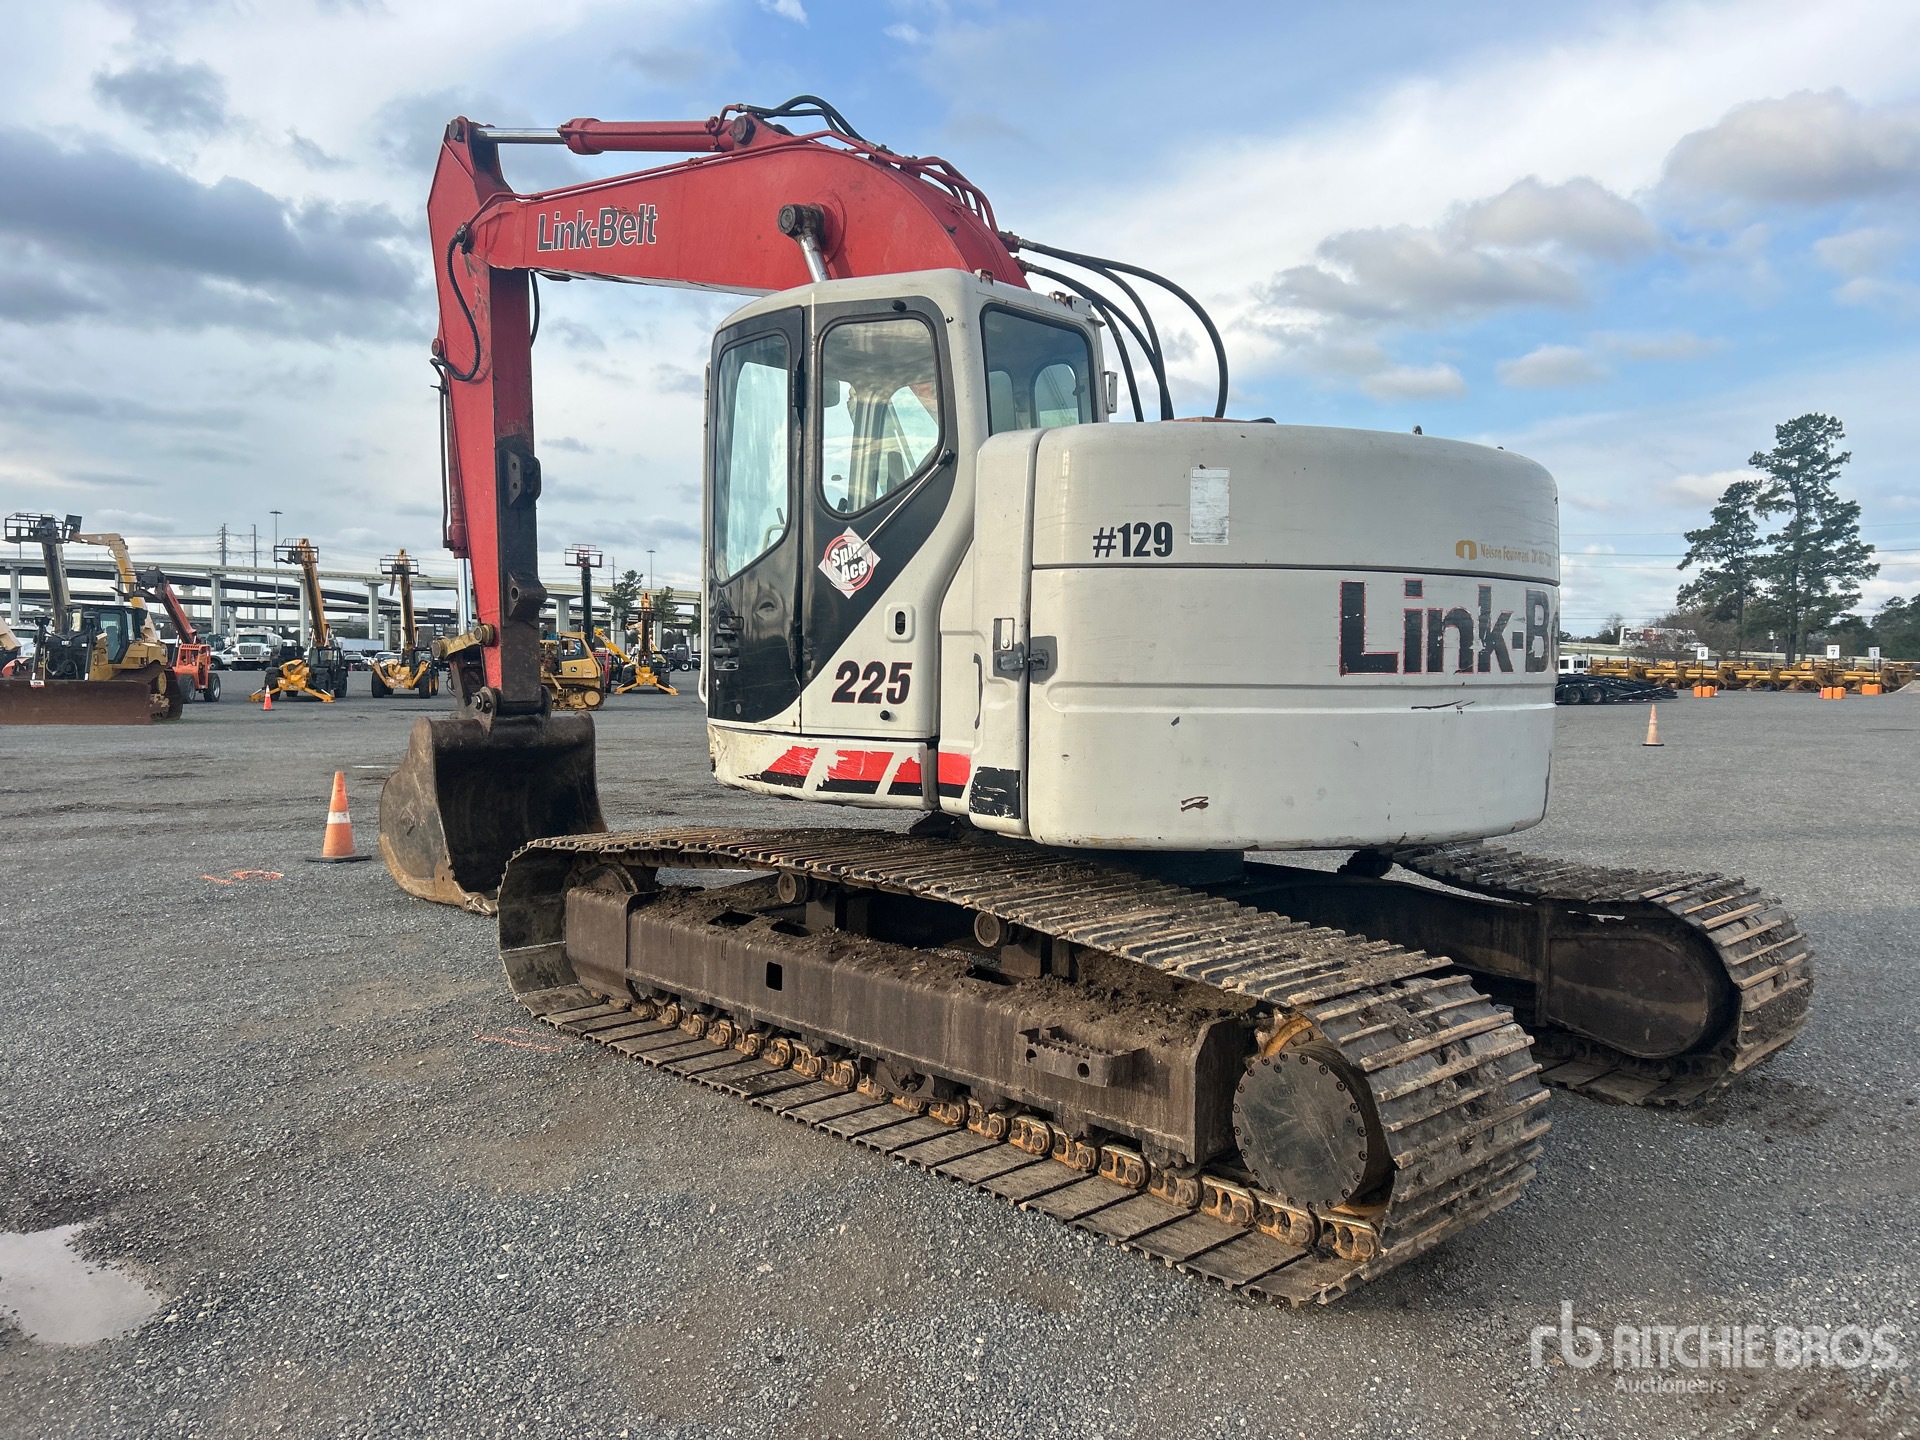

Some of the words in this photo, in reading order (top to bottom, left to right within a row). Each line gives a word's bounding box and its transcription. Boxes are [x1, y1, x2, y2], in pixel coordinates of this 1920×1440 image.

[537, 203, 658, 252] Link-Belt
[830, 542, 863, 567] Spin
[1092, 521, 1173, 558] #129
[1480, 543, 1502, 560] Nelson
[841, 560, 868, 583] Ace
[831, 660, 913, 705] 225
